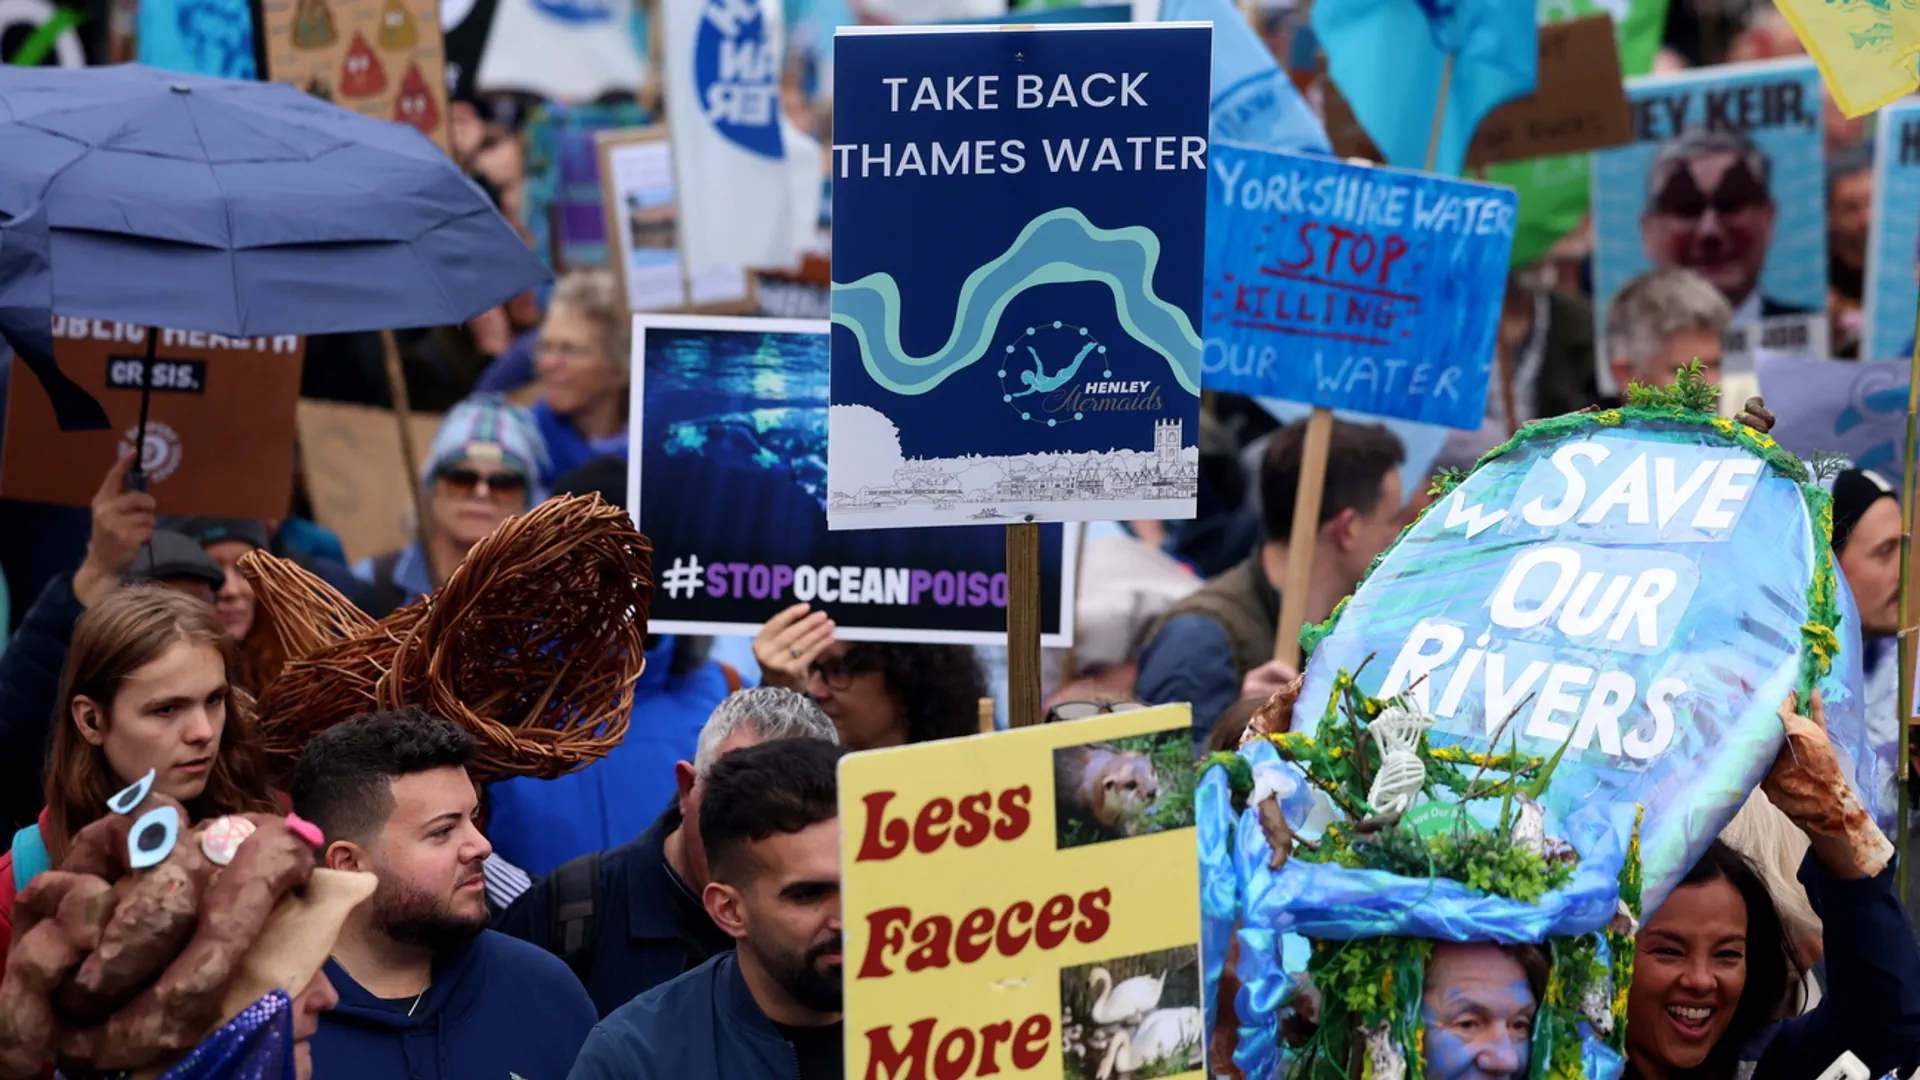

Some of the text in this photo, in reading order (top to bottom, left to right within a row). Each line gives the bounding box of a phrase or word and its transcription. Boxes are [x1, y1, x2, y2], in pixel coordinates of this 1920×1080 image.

[882, 72, 1149, 112] TAKE BACK
[832, 136, 1208, 178] THAMES WATER
[1212, 157, 1516, 237] YORKSHIRE WATER
[1276, 221, 1409, 286] STOP
[1233, 283, 1399, 330] KILLING
[110, 359, 200, 389] CRSIS.
[1041, 384, 1165, 413] Mermaids
[1084, 380, 1151, 395] HENLEY
[1201, 337, 1463, 403] OUR WATER
[1522, 442, 1765, 531] SAVE
[661, 553, 1008, 608] #STOPOCEANPOISO
[1489, 546, 1677, 647] OUR
[855, 783, 1032, 864] Less
[856, 886, 1112, 981] Faeces
[864, 1013, 1052, 1080] More
